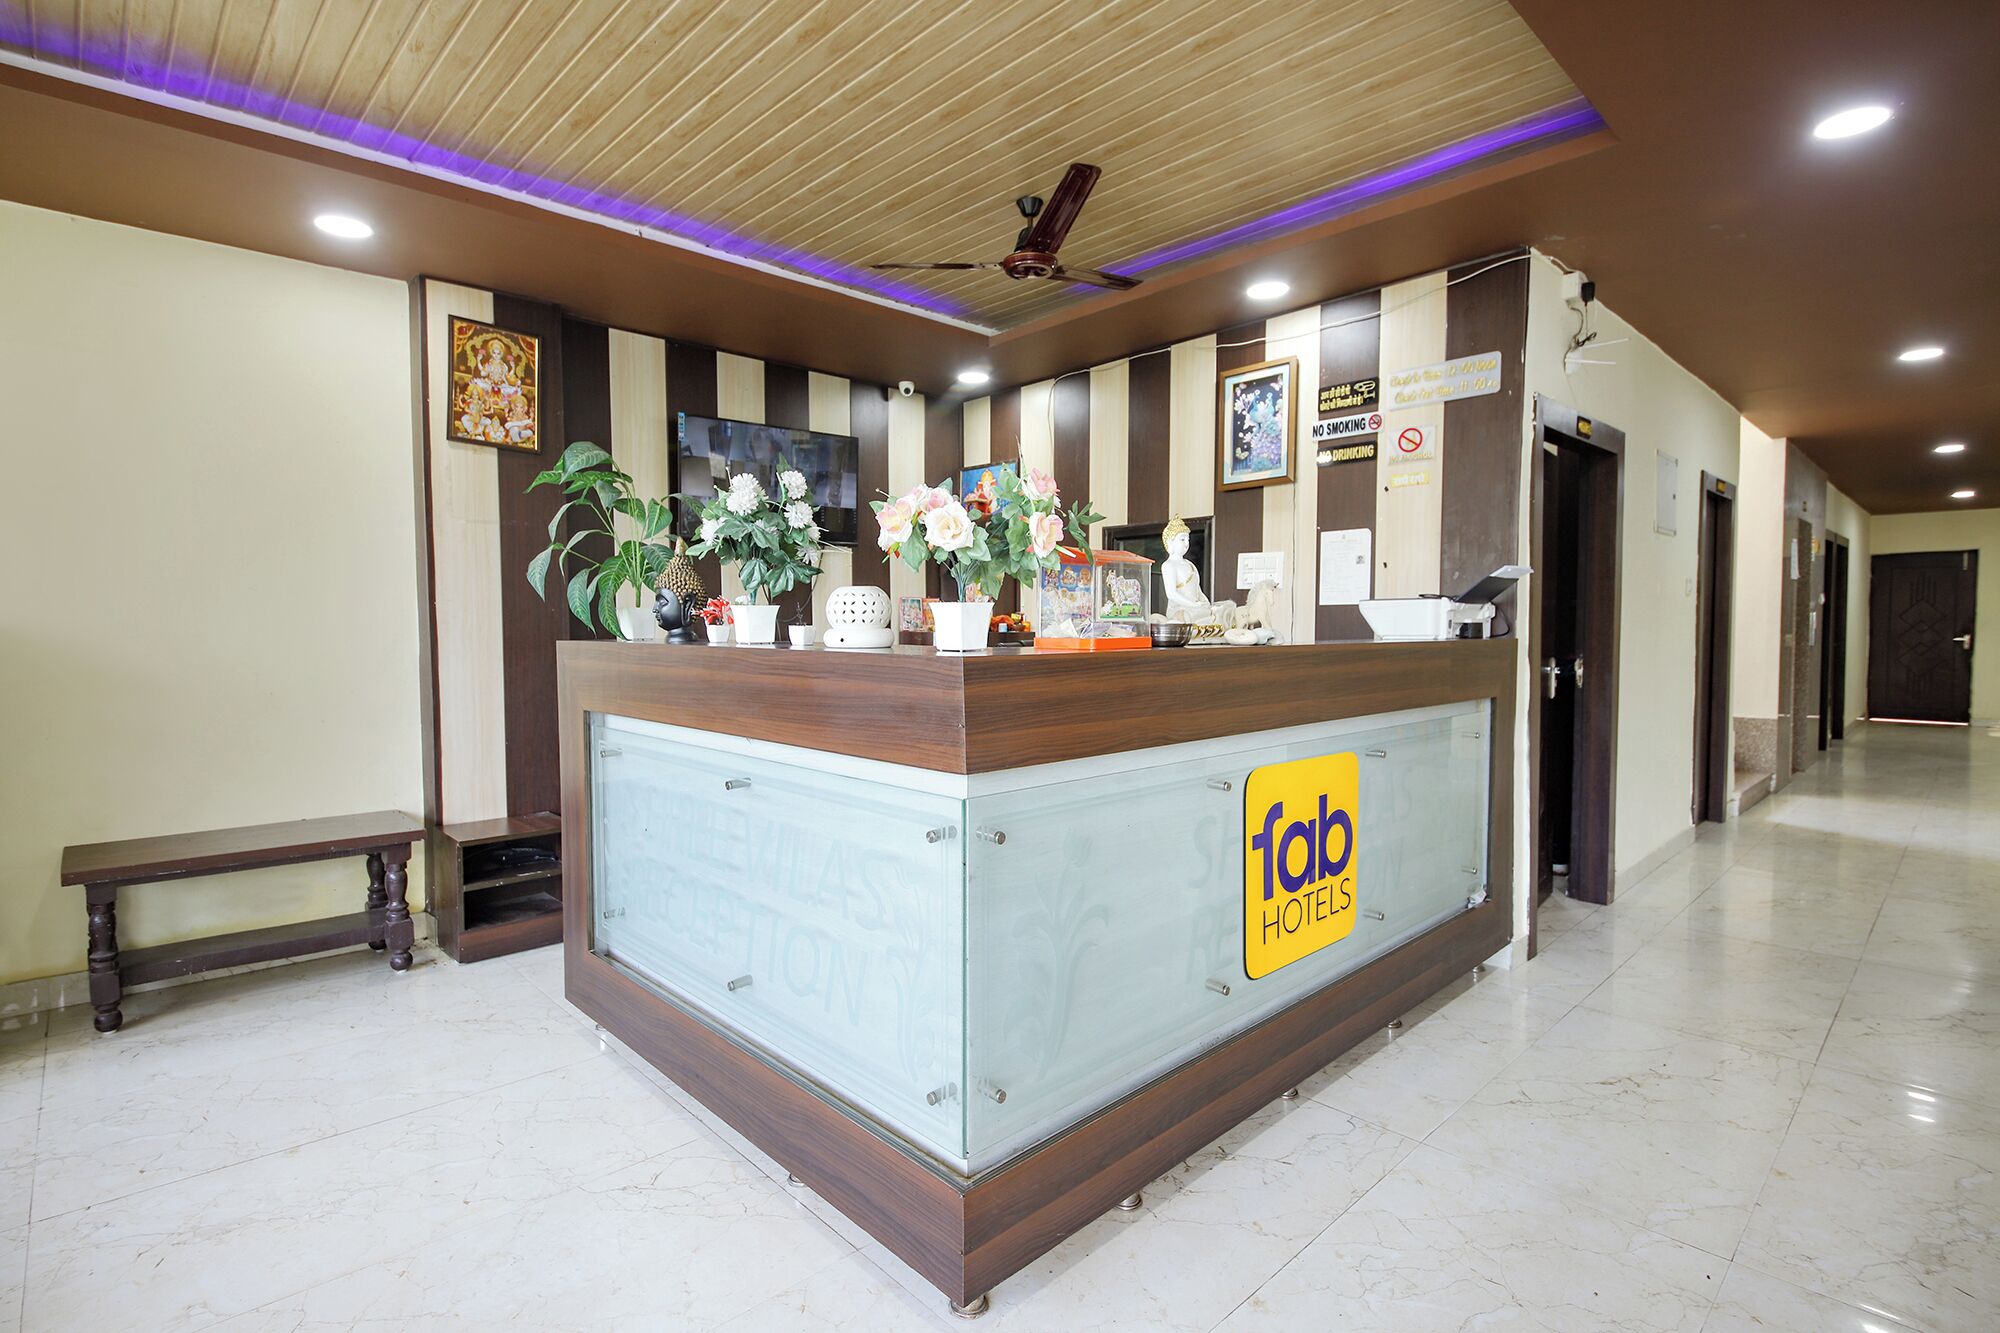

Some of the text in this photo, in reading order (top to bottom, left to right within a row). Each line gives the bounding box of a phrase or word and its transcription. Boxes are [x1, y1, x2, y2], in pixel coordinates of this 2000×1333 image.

[1312, 417, 1366, 438] NO SMOKING
[1332, 444, 1375, 462] DRINKING
[1252, 793, 1353, 901] fab
[1263, 878, 1351, 945] HOTELS
